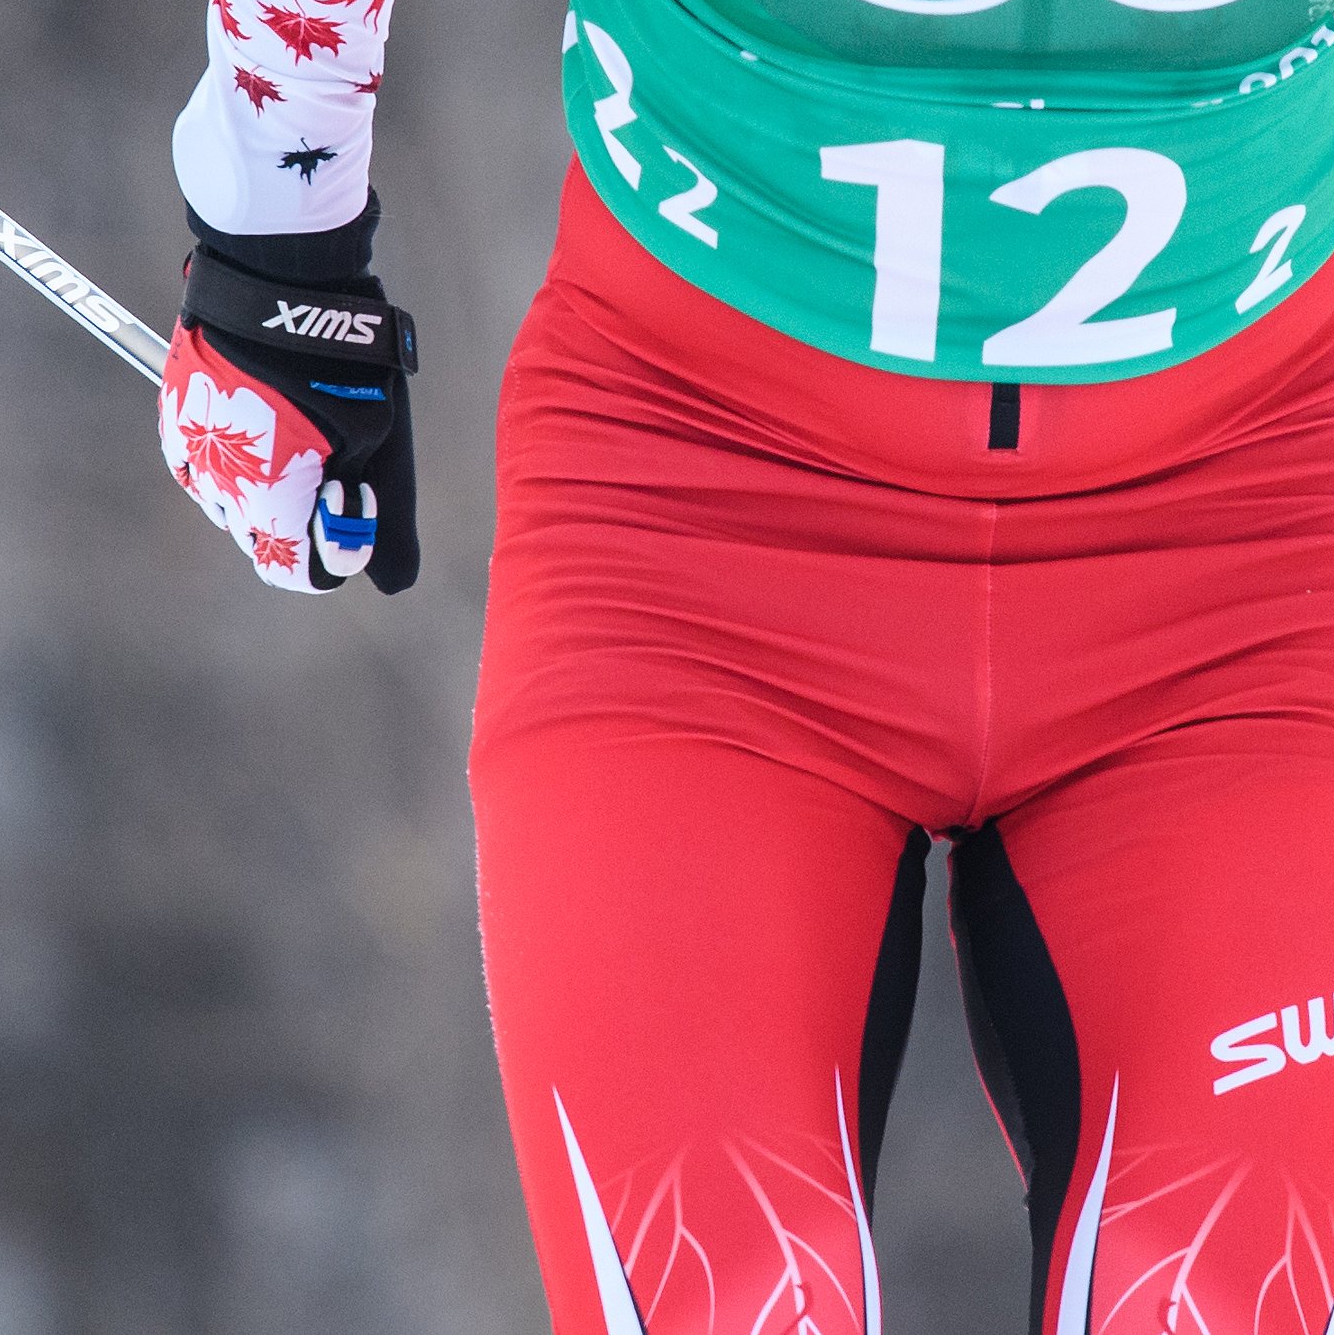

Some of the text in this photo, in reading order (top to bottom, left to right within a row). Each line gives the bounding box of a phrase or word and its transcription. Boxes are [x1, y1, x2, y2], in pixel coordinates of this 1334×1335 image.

[658, 144, 719, 249] 2
[820, 138, 1307, 366] 12 2
